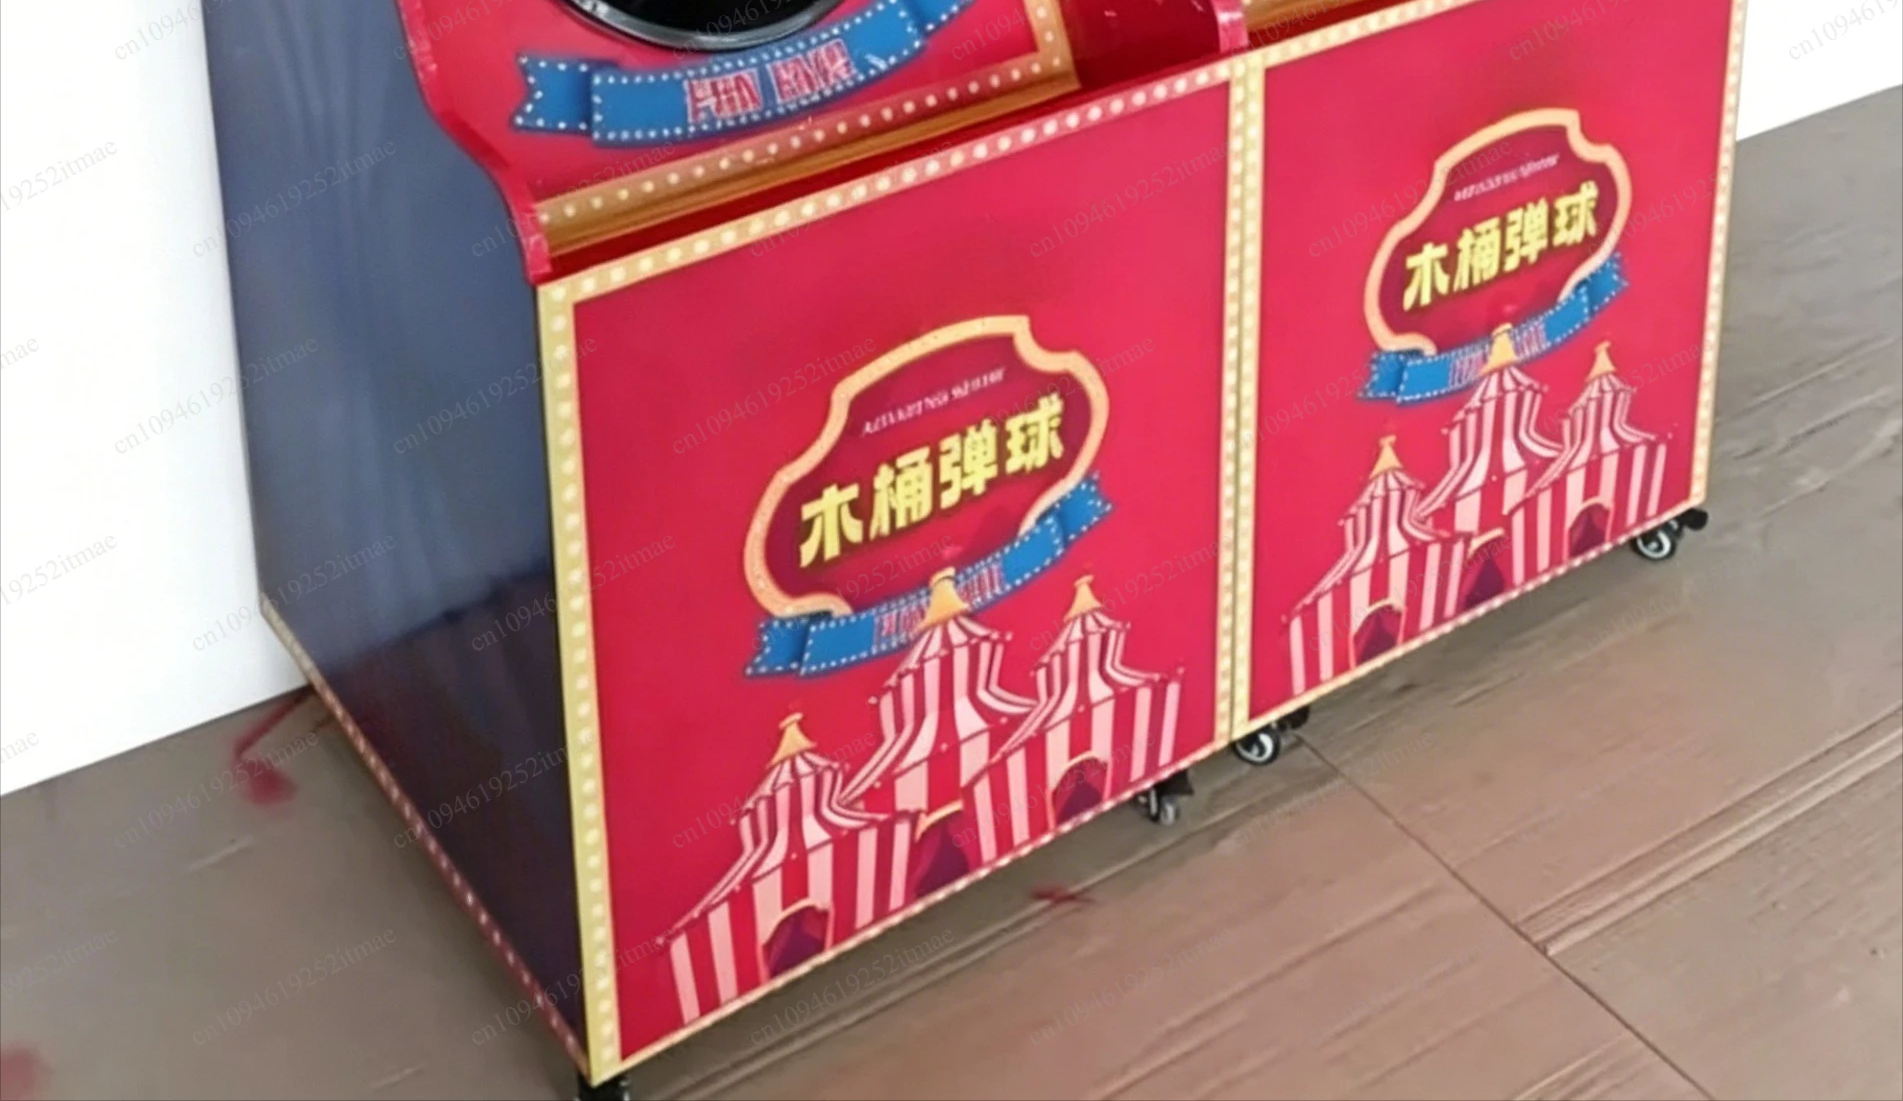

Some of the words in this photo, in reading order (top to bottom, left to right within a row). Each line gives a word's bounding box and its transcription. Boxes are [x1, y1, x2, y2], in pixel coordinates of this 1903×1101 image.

[1403, 180, 1598, 312] 木桶弹球
[799, 392, 1065, 568] 木桶弹球
